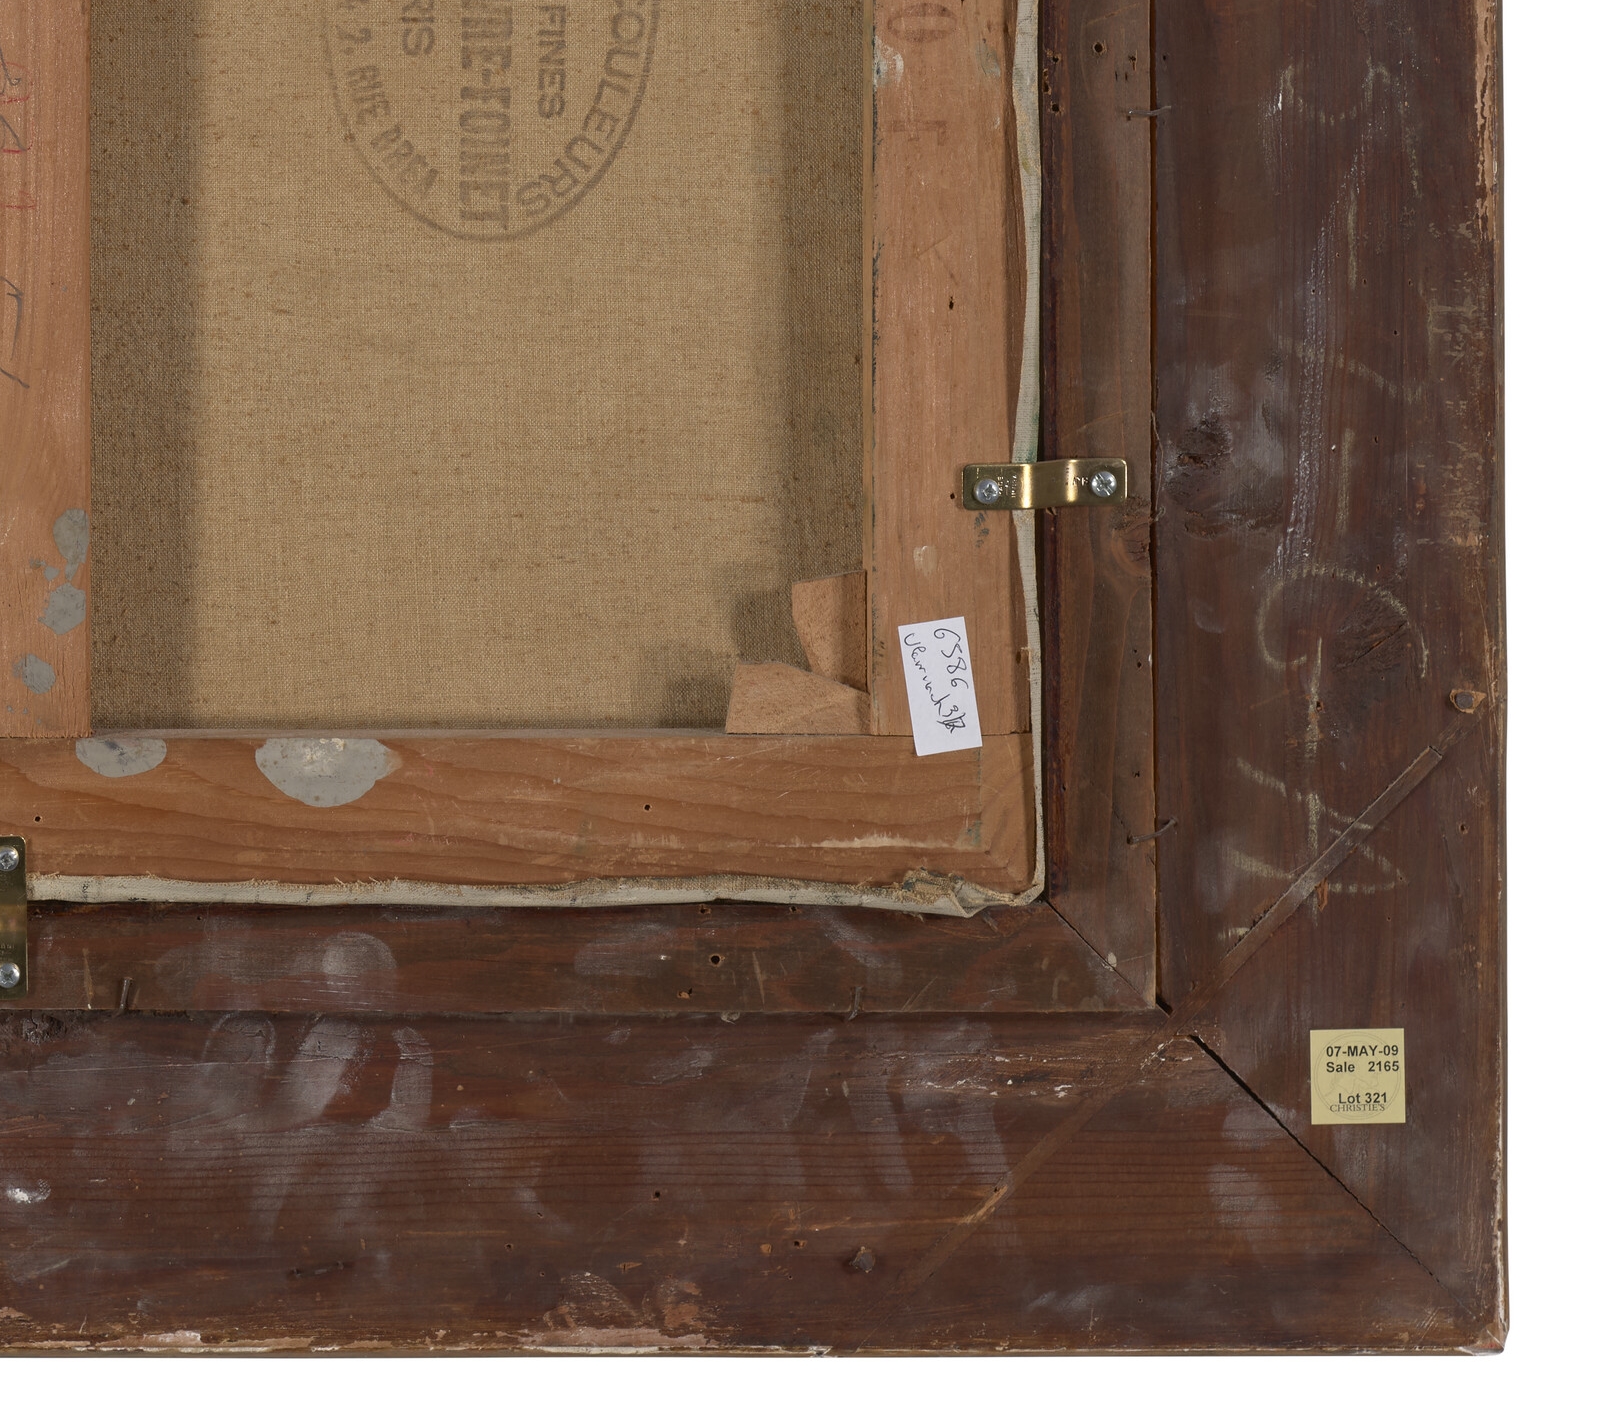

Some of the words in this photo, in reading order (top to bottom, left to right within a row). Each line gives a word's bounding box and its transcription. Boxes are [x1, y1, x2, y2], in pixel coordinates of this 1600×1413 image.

[536, 5, 567, 120] FINES
[933, 628, 969, 690] 6586
[1326, 1045, 1399, 1057] 07-MAY-09
[1326, 1061, 1355, 1073] Sale
[1368, 1060, 1400, 1072] 2165
[1338, 1092, 1360, 1104] Lot
[1365, 1092, 1387, 1104] 321
[1329, 1103, 1386, 1113] CHRISTIE'S
